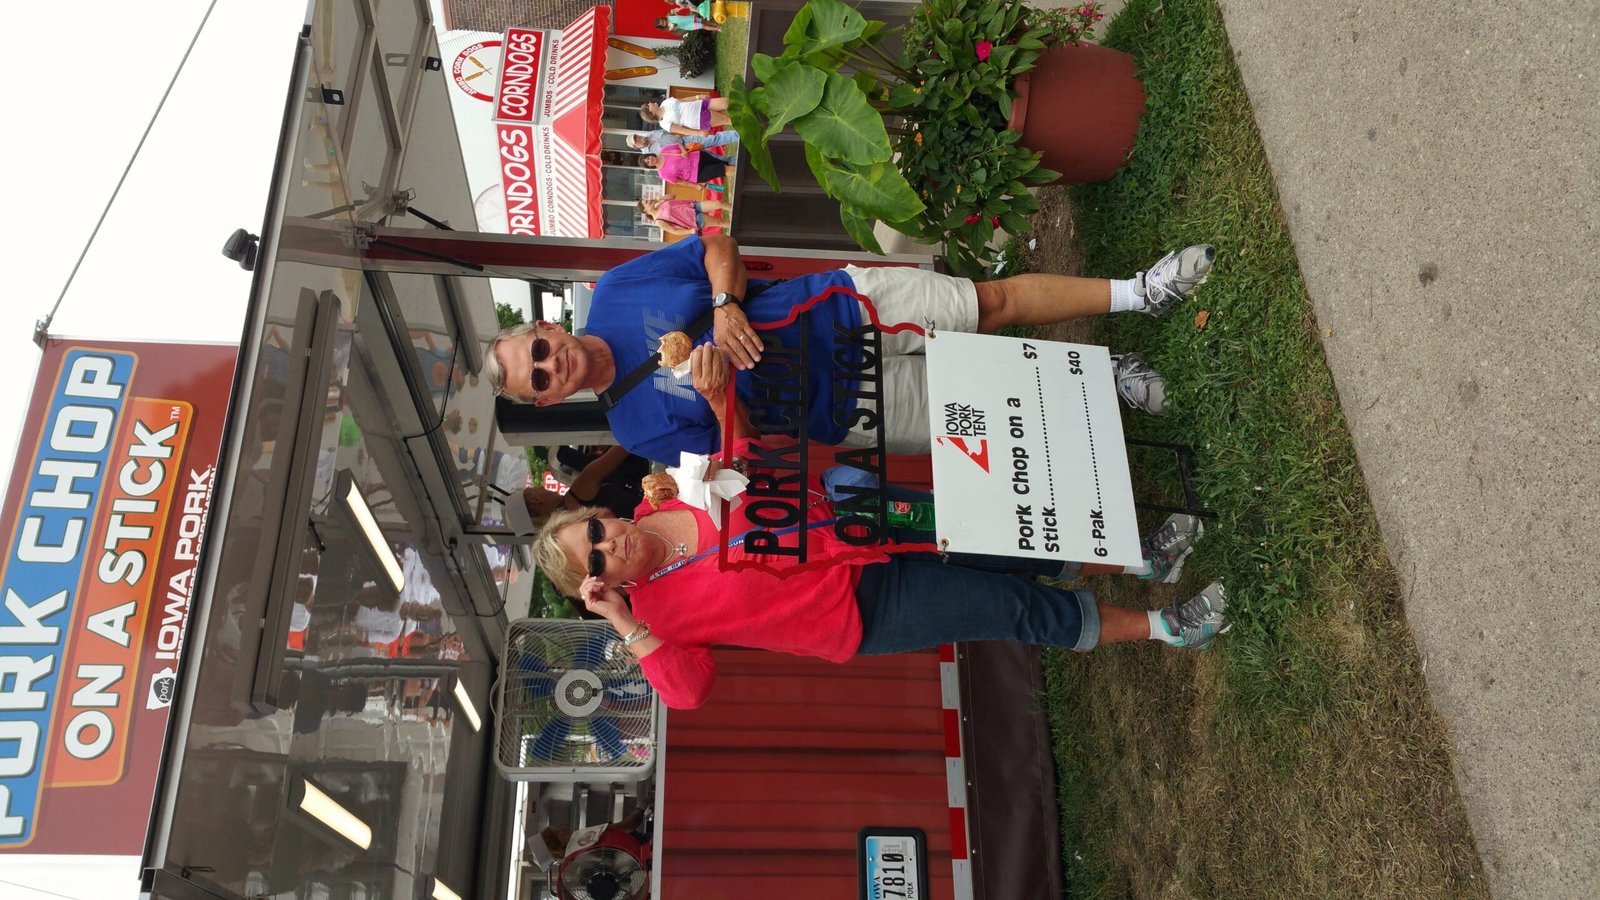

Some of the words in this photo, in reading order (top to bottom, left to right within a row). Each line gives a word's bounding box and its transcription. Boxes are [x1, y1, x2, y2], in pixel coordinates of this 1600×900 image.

[461, 43, 484, 56] DOGS
[550, 39, 559, 64] DRINKS
[454, 56, 465, 74] CORN
[501, 34, 536, 116] CORNDOGS
[547, 66, 556, 85] COLD
[456, 77, 476, 95] JUMBO
[544, 90, 553, 117] JUMBOS
[542, 127, 551, 154] DRINKS
[543, 155, 552, 174] COLD
[545, 177, 554, 213] CORNDOGS
[1023, 343, 1038, 360] $7
[1067, 351, 1083, 376] $40
[748, 335, 800, 432] CHOP
[833, 319, 878, 431] STICK
[1006, 398, 1020, 408] a
[944, 402, 959, 436] IOWA
[958, 405, 972, 437] PORK
[972, 408, 986, 437] TENT
[1007, 416, 1024, 439] on
[17, 355, 123, 563] CHOP
[834, 448, 879, 474] A
[1011, 447, 1030, 495] Chop
[98, 420, 179, 586] STICK
[744, 441, 800, 556] PORK
[833, 484, 880, 546] ON
[1015, 504, 1035, 551] Pork
[155, 569, 191, 659] IOWA
[175, 468, 212, 560] PORK
[87, 601, 137, 648] A
[159, 678, 171, 701] pork
[64, 664, 124, 759] ON
